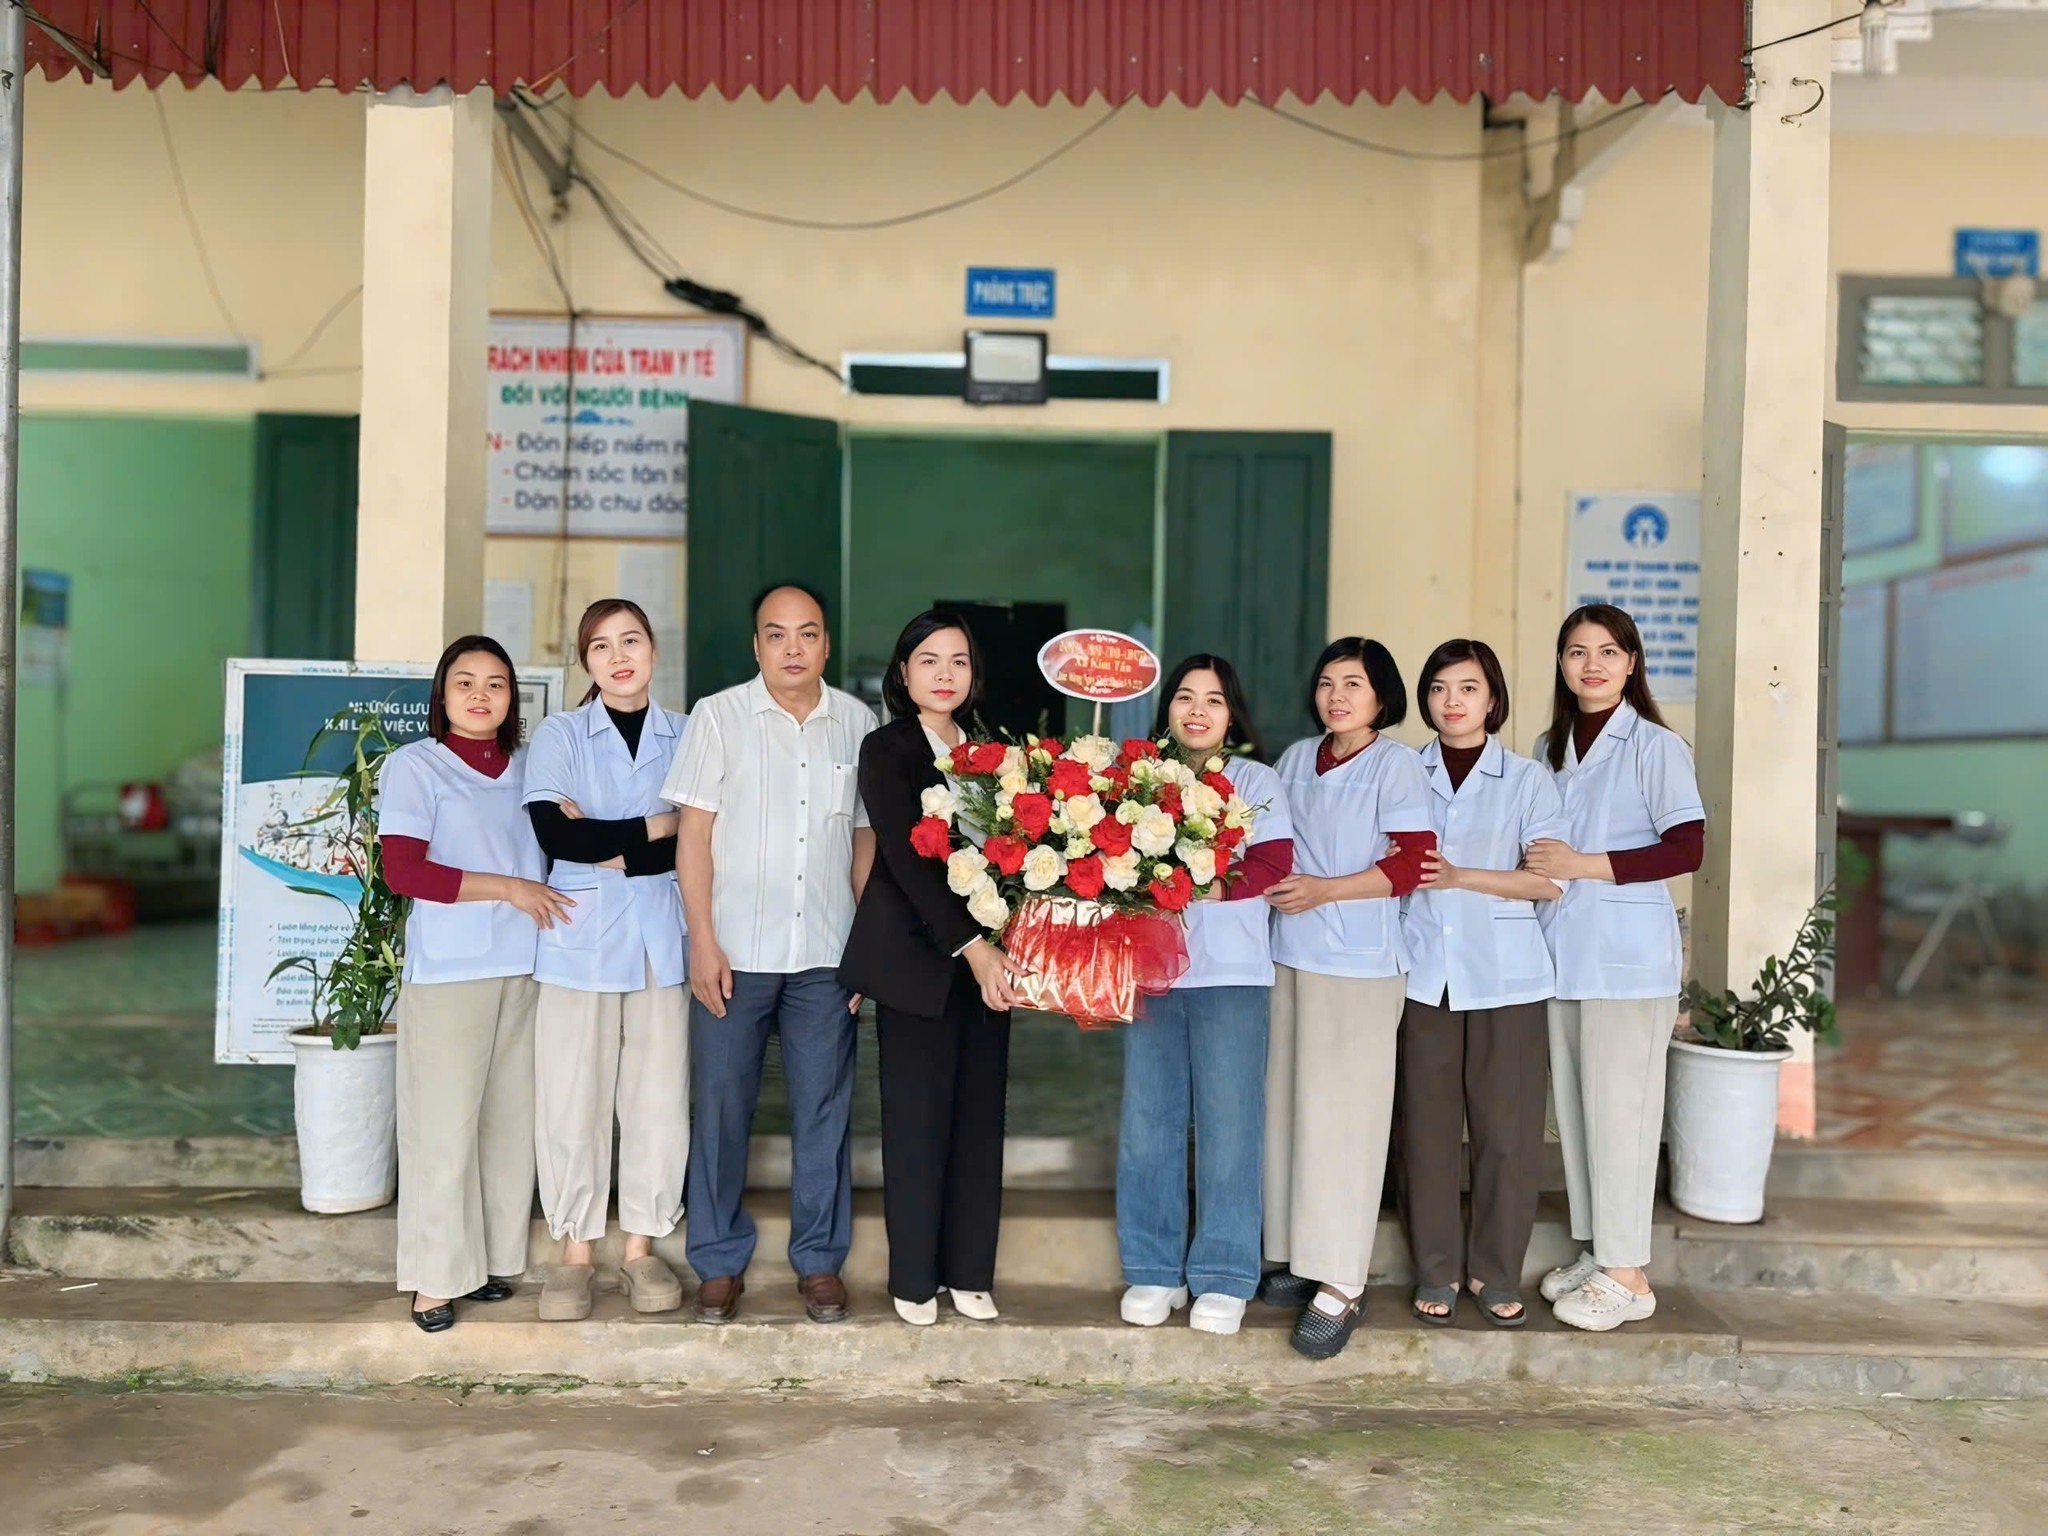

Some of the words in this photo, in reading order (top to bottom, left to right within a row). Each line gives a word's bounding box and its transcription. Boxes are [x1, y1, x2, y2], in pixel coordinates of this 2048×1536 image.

[973, 275, 1015, 304] PHÒNG
[488, 338, 532, 372] RÁCH
[537, 345, 588, 373] NHIM
[592, 337, 625, 374] CỦA
[679, 350, 689, 376] Y
[694, 340, 716, 378] TẾ
[565, 433, 609, 455] iếp
[403, 701, 430, 715] LƯU
[384, 717, 414, 736] VIỆC
